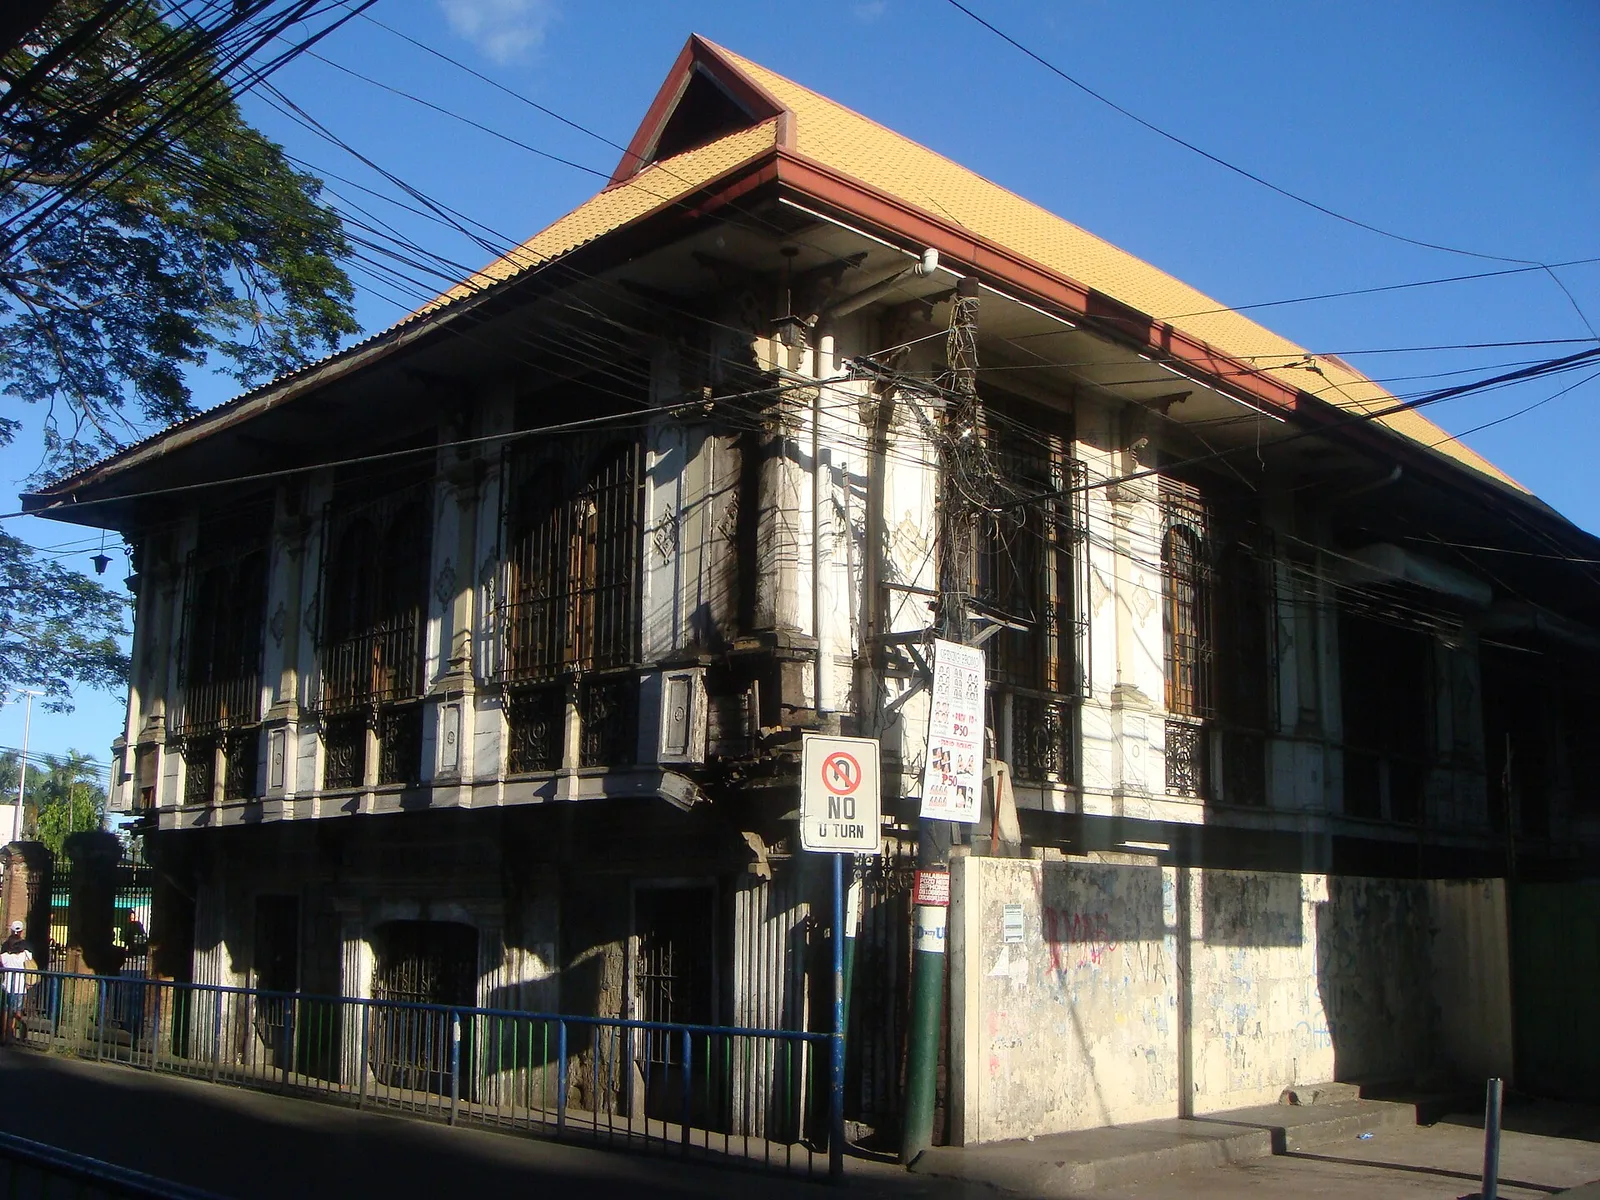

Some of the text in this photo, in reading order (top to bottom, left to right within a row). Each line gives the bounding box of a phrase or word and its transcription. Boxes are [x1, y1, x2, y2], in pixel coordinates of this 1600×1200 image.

[828, 796, 855, 820] NO
[819, 823, 864, 839] U TURN
